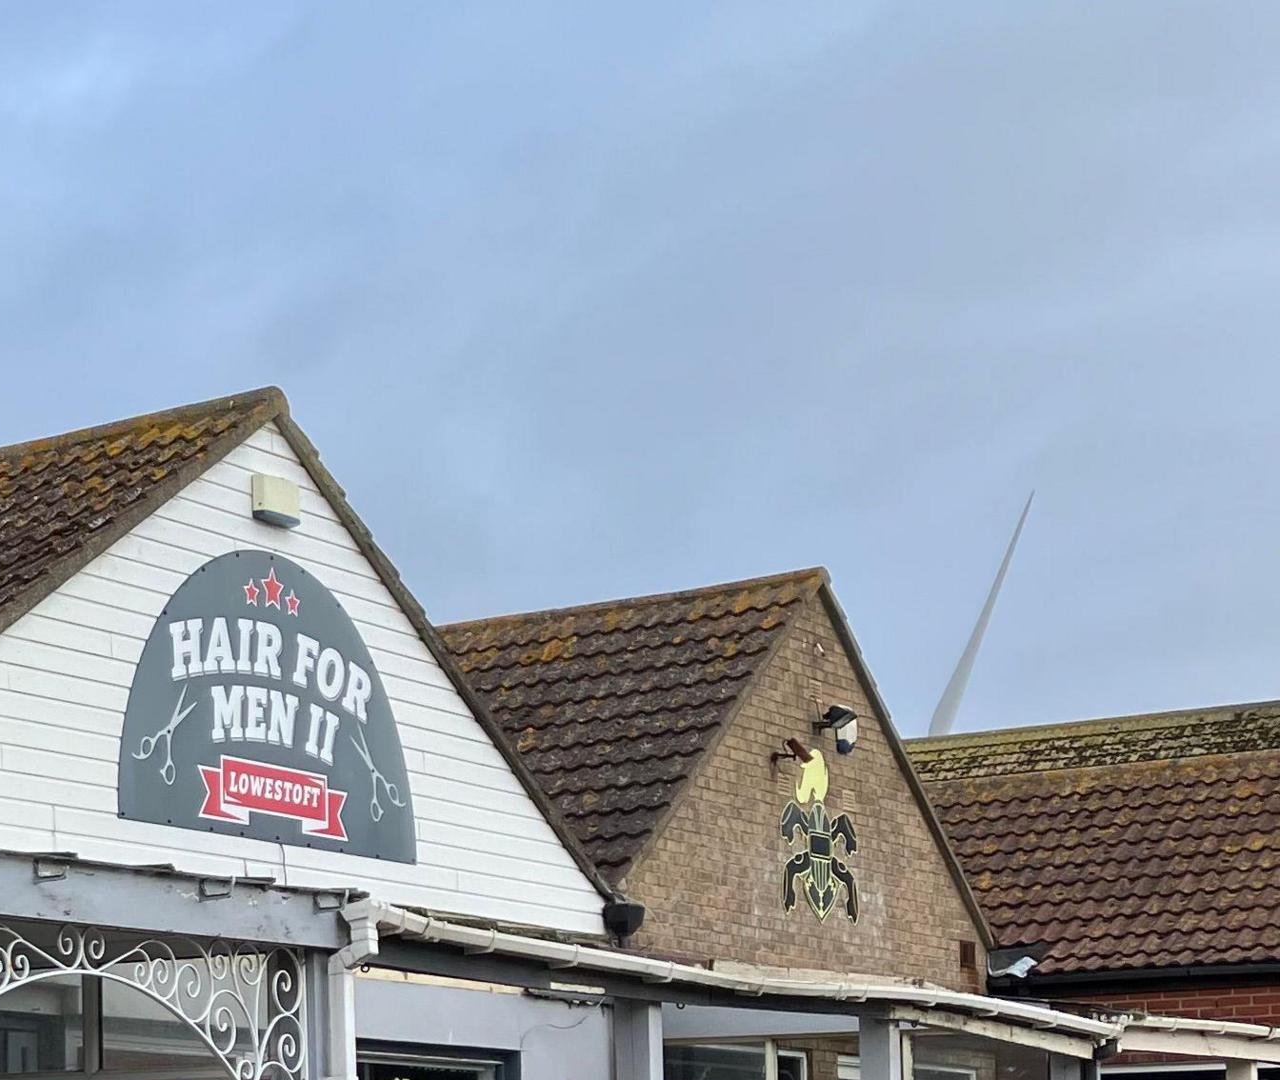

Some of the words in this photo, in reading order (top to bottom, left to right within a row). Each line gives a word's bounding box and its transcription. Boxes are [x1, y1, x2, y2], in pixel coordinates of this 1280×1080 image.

[169, 617, 284, 681] HAIR
[292, 633, 372, 725] FOR
[211, 685, 300, 748] MEN
[305, 703, 340, 767] II
[229, 771, 321, 808] LOWESTOFT
